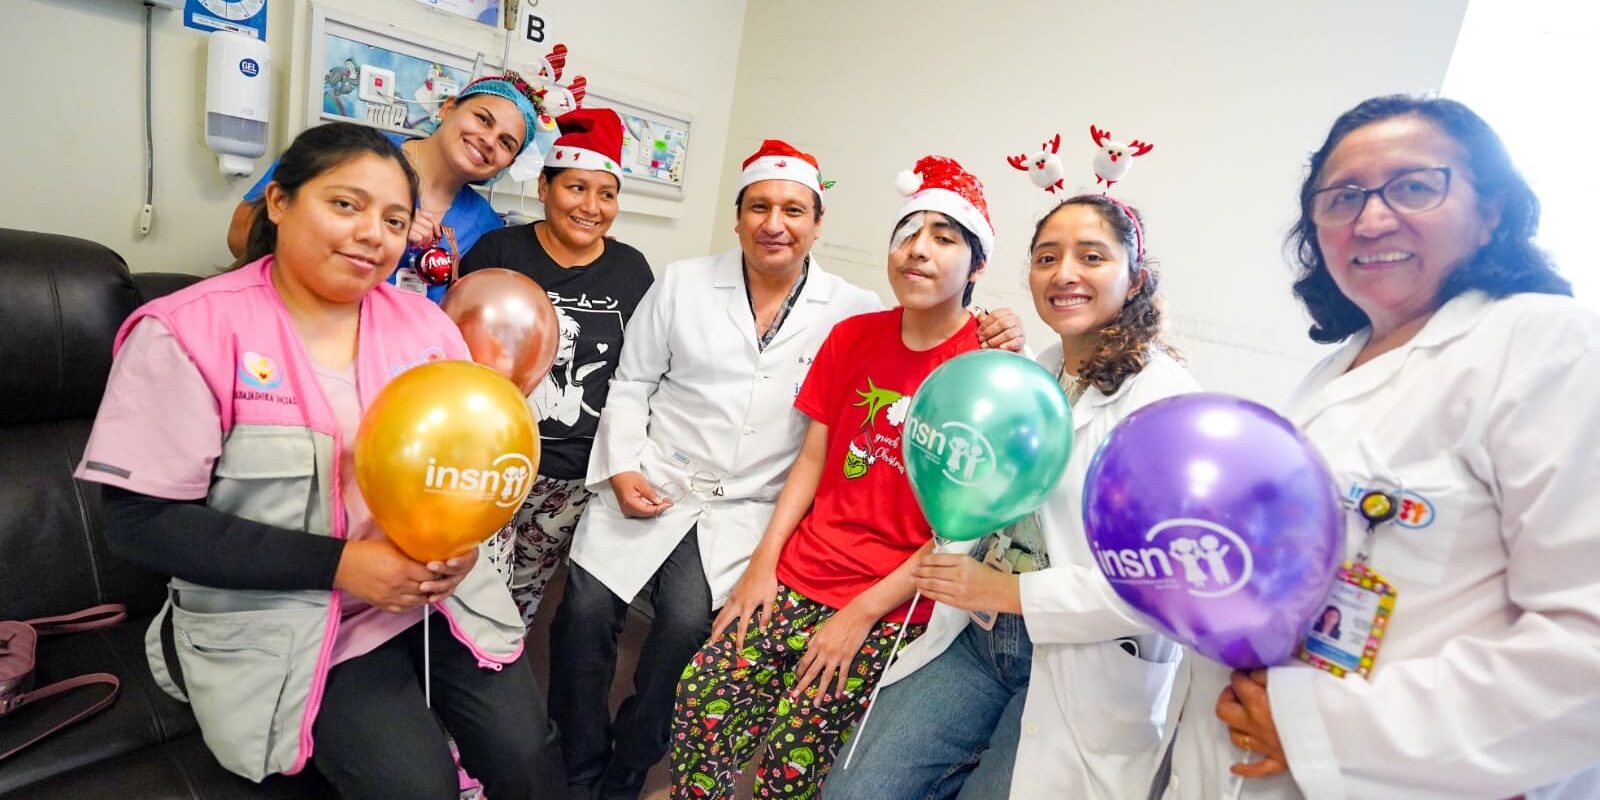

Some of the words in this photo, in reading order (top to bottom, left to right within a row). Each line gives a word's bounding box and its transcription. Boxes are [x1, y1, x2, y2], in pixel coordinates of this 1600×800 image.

[526, 13, 545, 43] B
[242, 61, 257, 72] GEL
[424, 457, 500, 492] insn
[1094, 541, 1174, 578] insn
[722, 710, 748, 737] GRINCH
